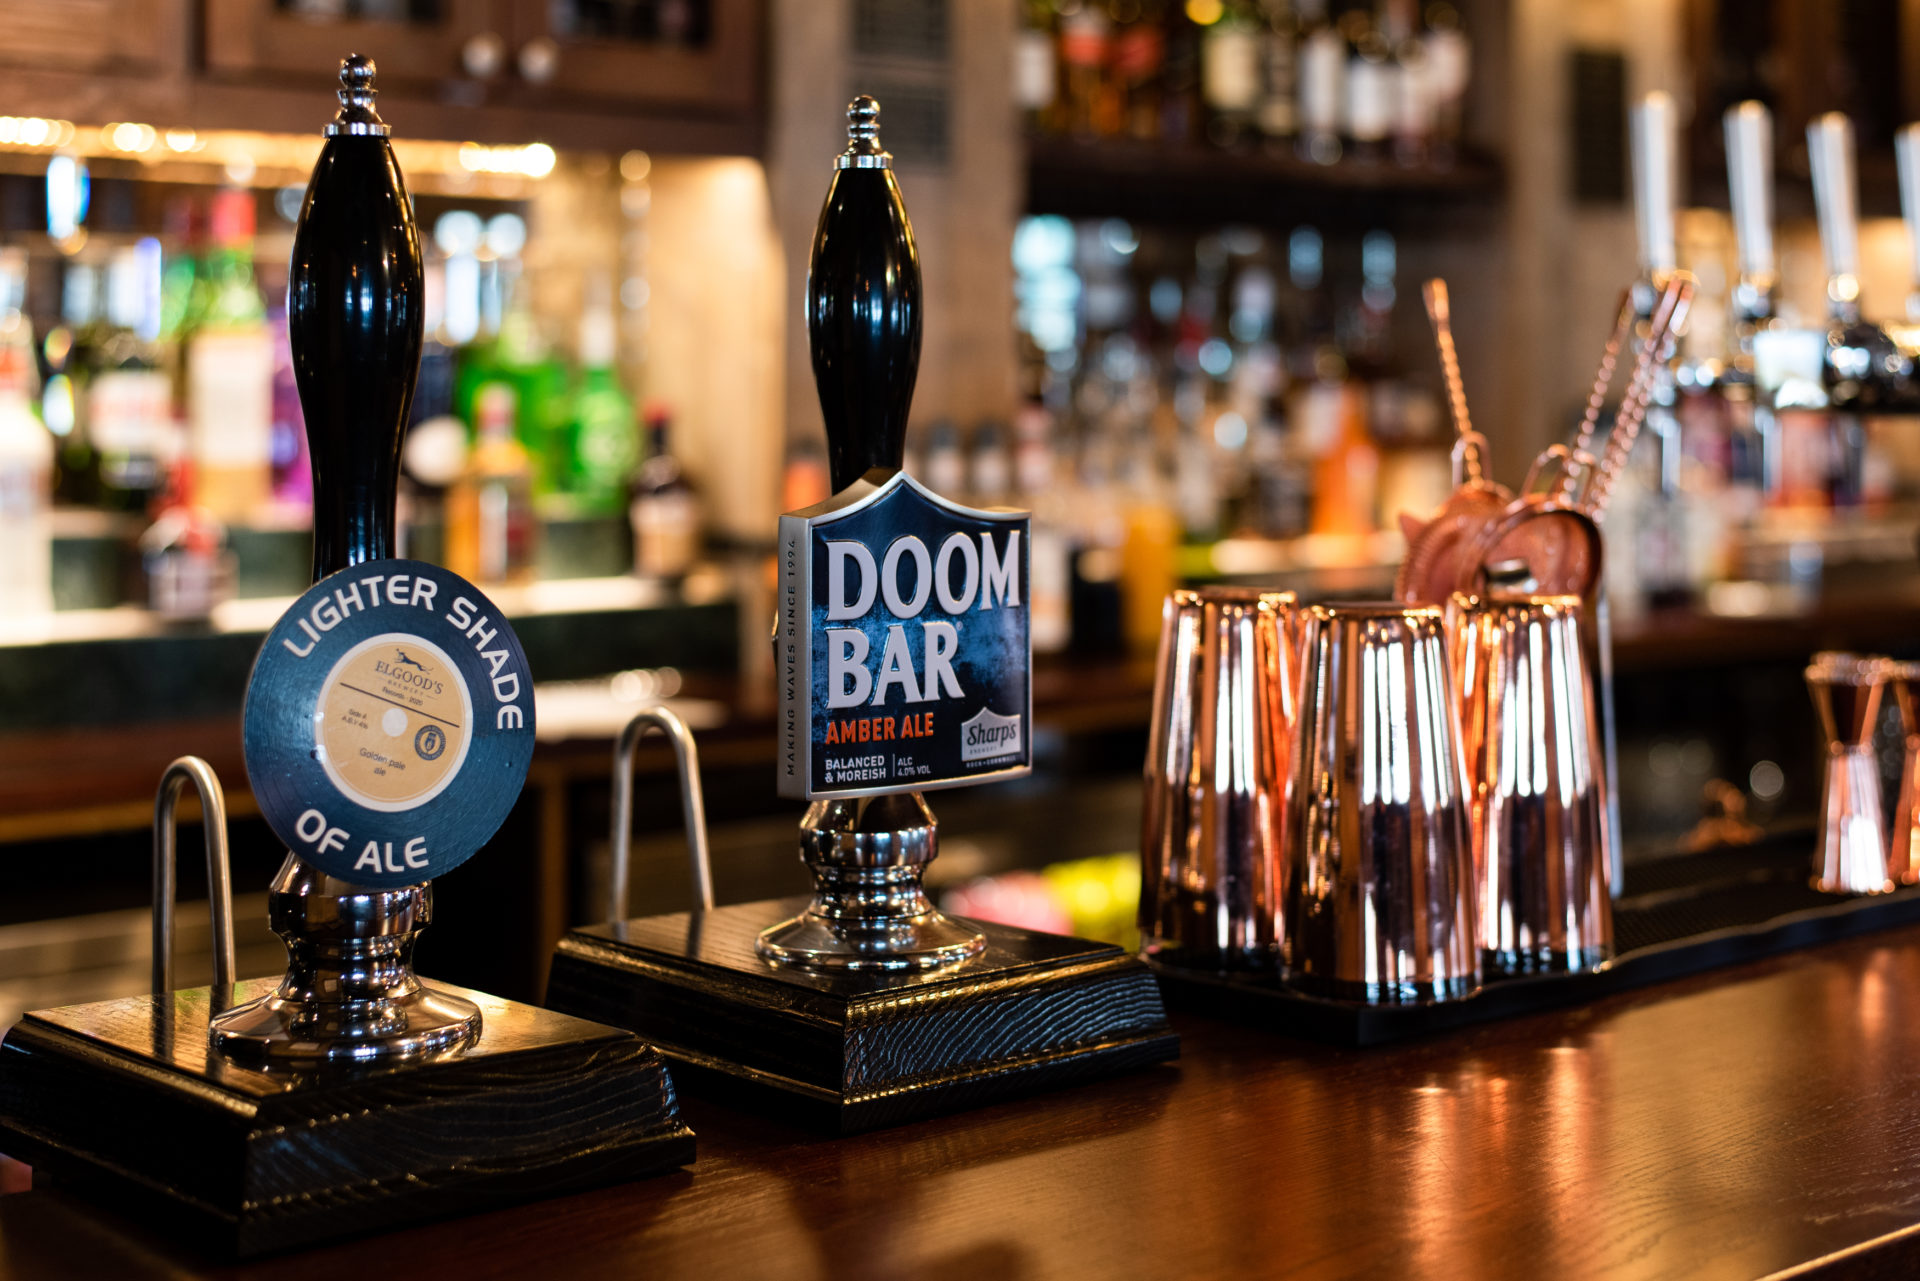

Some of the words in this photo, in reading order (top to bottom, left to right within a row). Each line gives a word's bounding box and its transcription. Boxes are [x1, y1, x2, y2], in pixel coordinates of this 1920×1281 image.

[825, 529, 1021, 621] DOOM
[787, 585, 795, 637] SINCE
[283, 574, 438, 658] LIGHTER
[446, 596, 524, 730] SHADE
[826, 622, 965, 710] BAR
[375, 660, 444, 695] ELGOOD'S
[787, 642, 795, 700] WAVES
[787, 709, 795, 776] MAKING
[825, 718, 896, 745] AMBER
[900, 712, 934, 738] ALE
[967, 722, 1017, 748] Sharp's
[359, 747, 388, 764] Golden
[388, 758, 406, 771] pale
[373, 767, 387, 777] ale
[825, 755, 886, 773] BALANCED
[825, 772, 834, 784] &
[836, 767, 887, 782] MOREISH
[897, 757, 913, 767] ALC
[897, 766, 915, 777] 4.0%
[916, 764, 931, 775] VOL
[295, 808, 350, 854] OF
[354, 836, 430, 874] ALE
